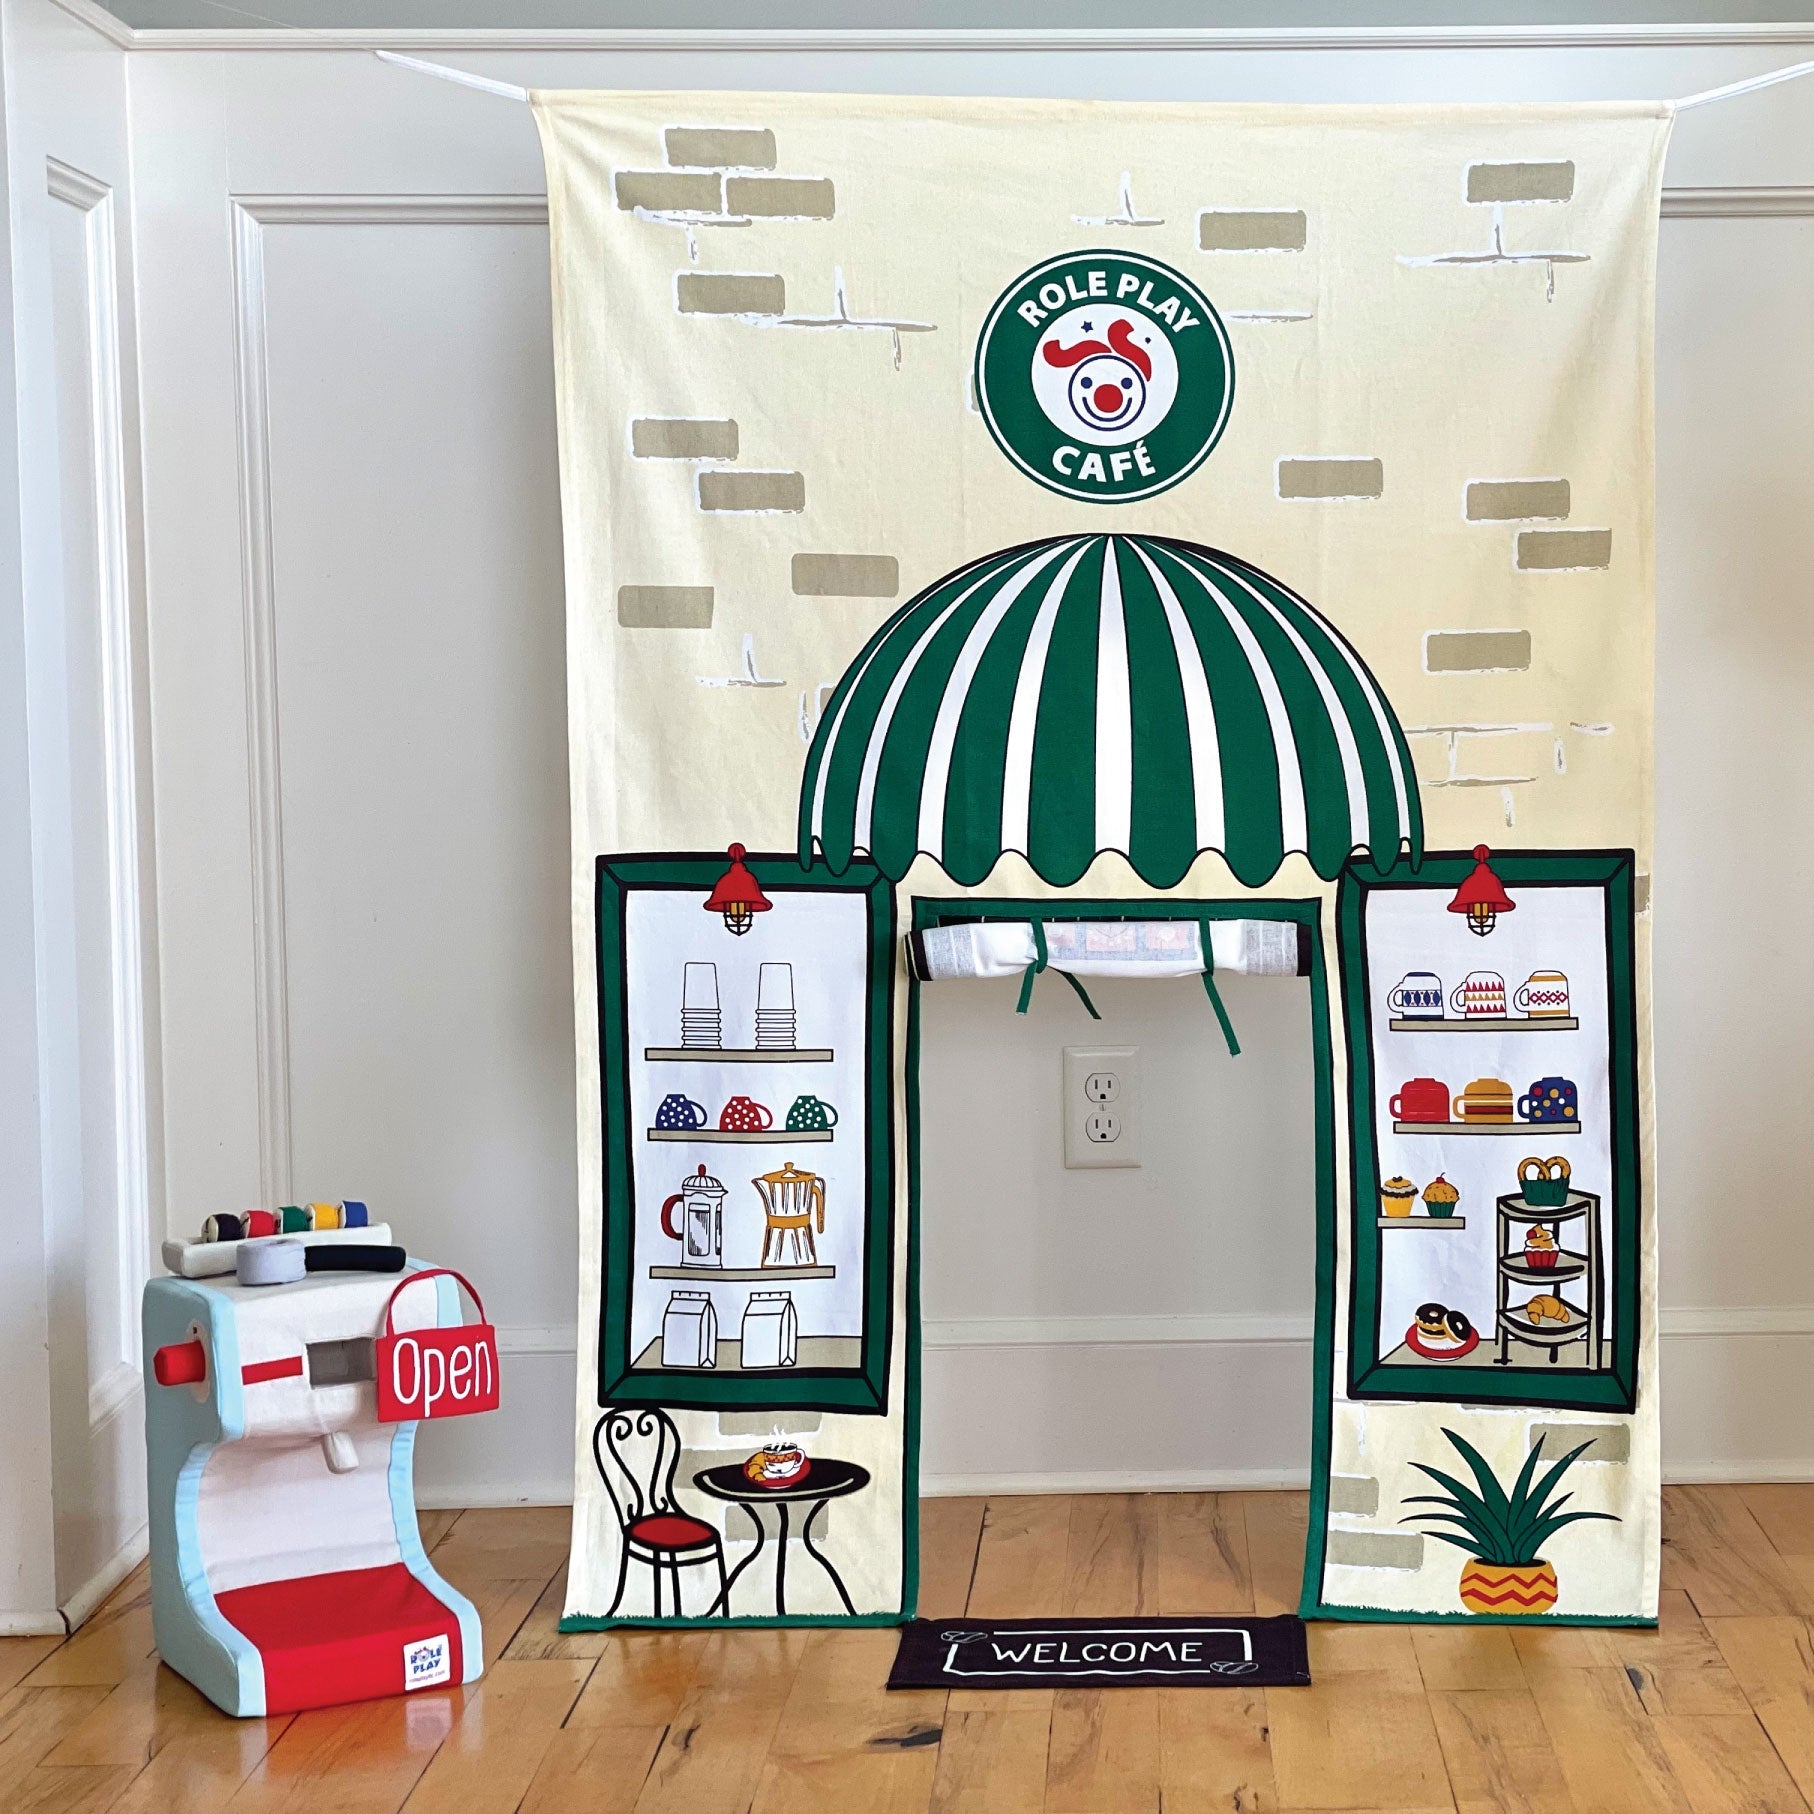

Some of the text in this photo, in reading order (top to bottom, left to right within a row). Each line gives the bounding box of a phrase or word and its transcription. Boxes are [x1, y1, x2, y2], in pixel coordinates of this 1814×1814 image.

[1017, 271, 1201, 333] ROLE PLAY
[1052, 440, 1156, 482] CAFÉ
[393, 1338, 492, 1418] Open
[413, 1658, 441, 1674] PLAY
[991, 1642, 1203, 1663] WELCOME
